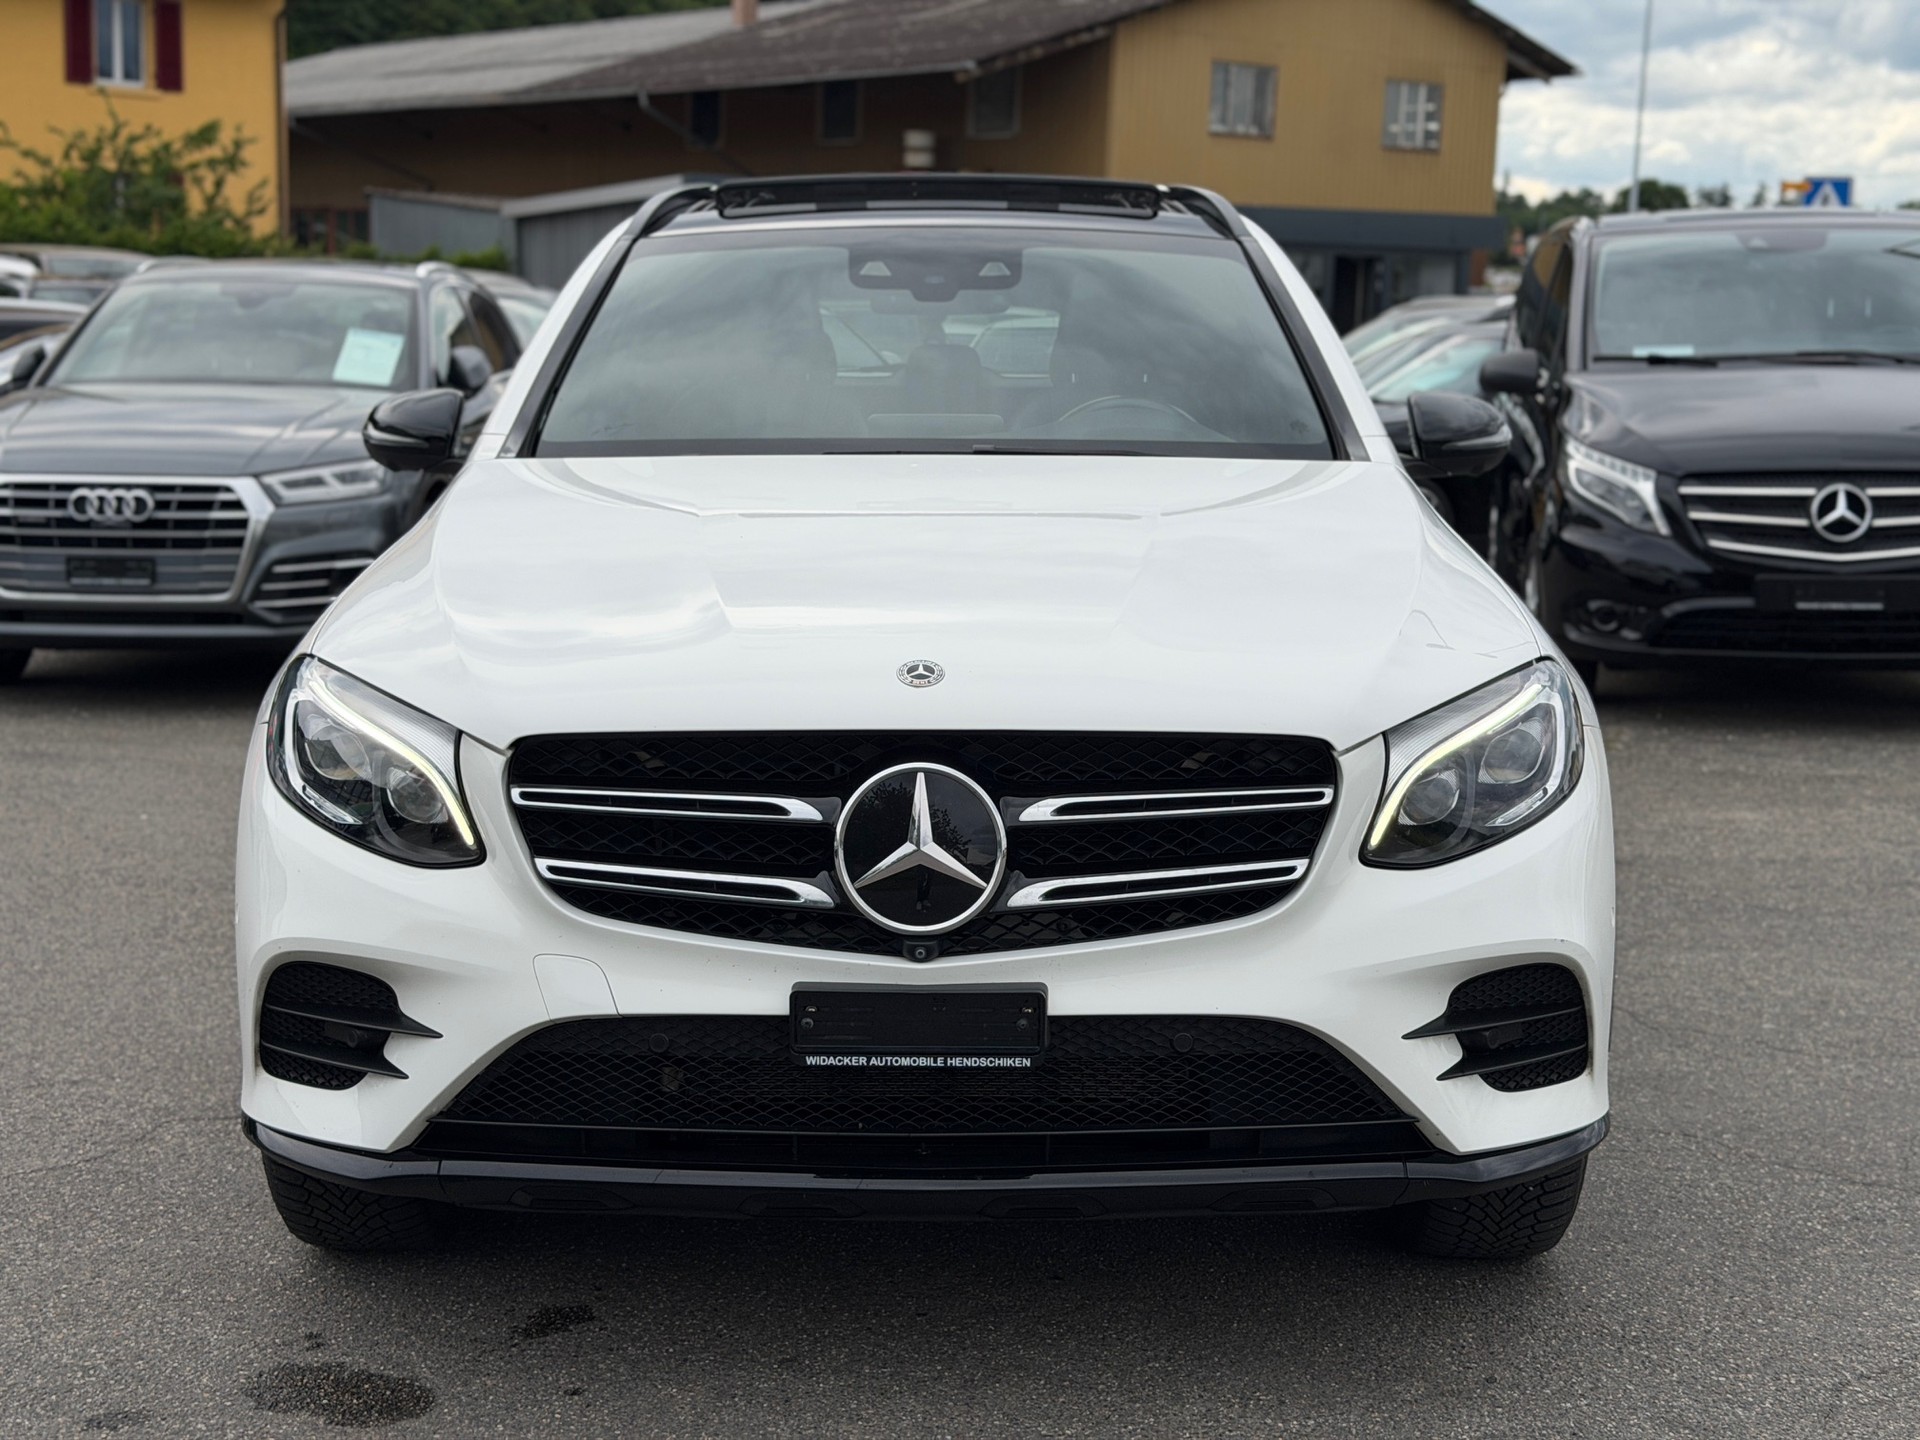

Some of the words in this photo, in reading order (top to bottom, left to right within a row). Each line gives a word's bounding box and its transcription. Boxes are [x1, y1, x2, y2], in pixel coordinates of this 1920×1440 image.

[805, 1056, 868, 1066] WIDACKER
[869, 1056, 945, 1067] AUTOMOBILE
[947, 1057, 1031, 1067] HENDSCHIKEN
